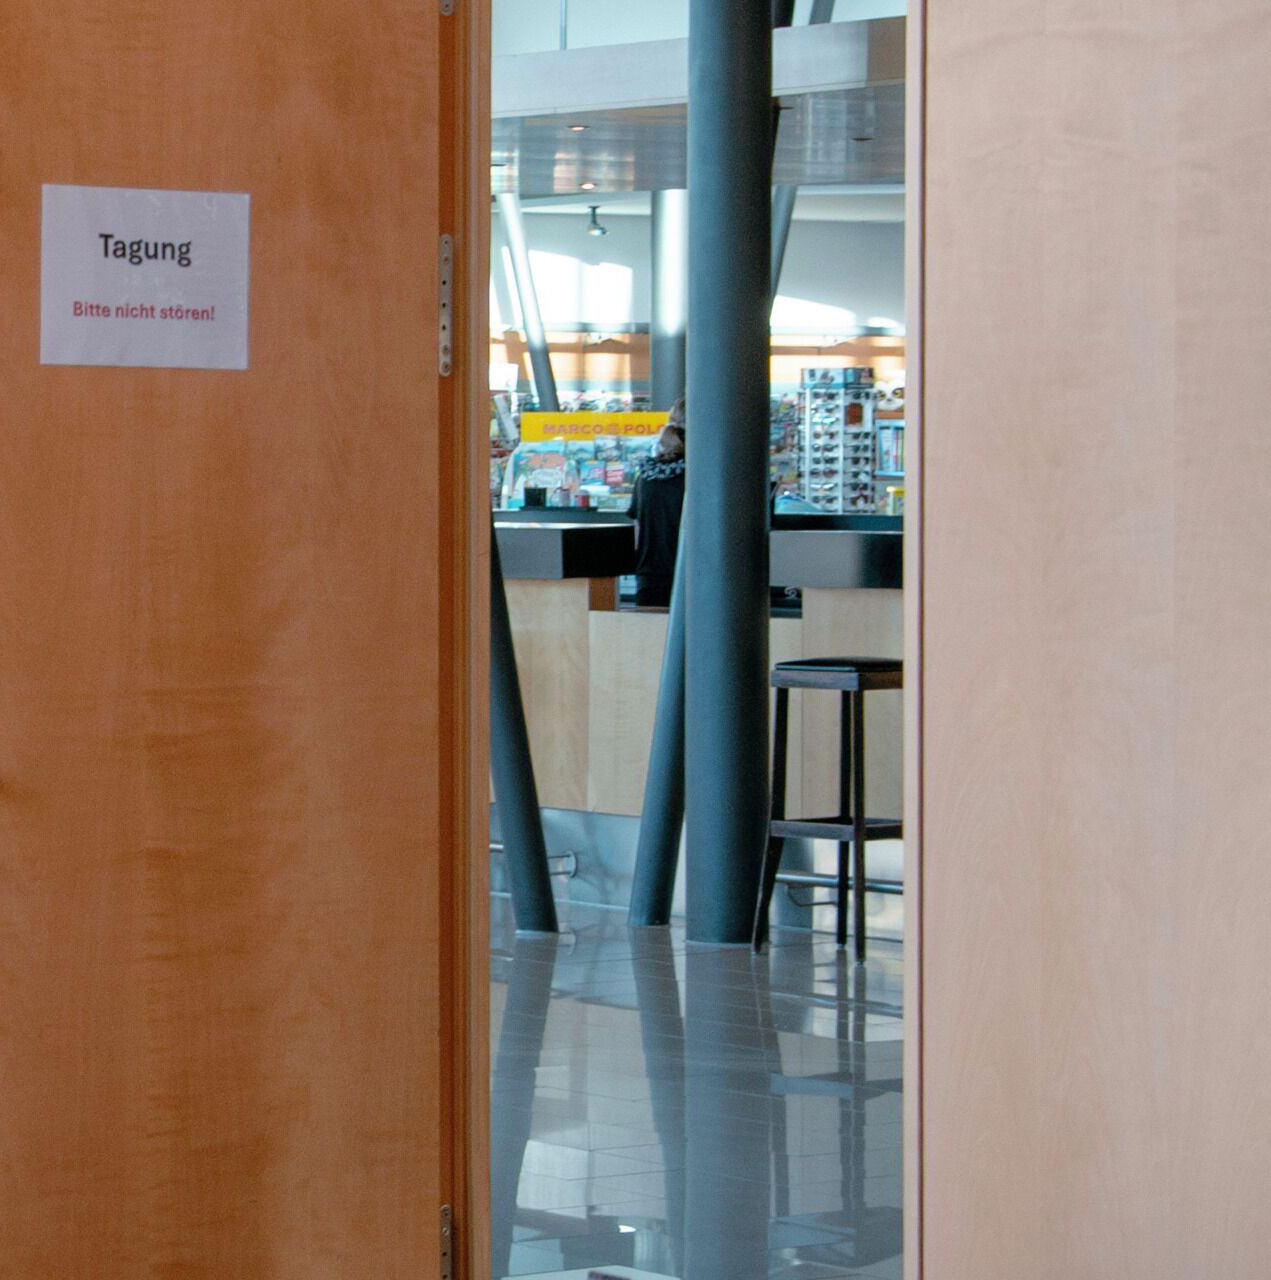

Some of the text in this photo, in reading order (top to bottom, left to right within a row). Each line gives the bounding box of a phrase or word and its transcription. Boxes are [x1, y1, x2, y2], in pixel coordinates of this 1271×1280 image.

[98, 233, 192, 268] Tagung
[72, 300, 215, 321] Bitte nicht stören!
[543, 424, 604, 435] MARCO
